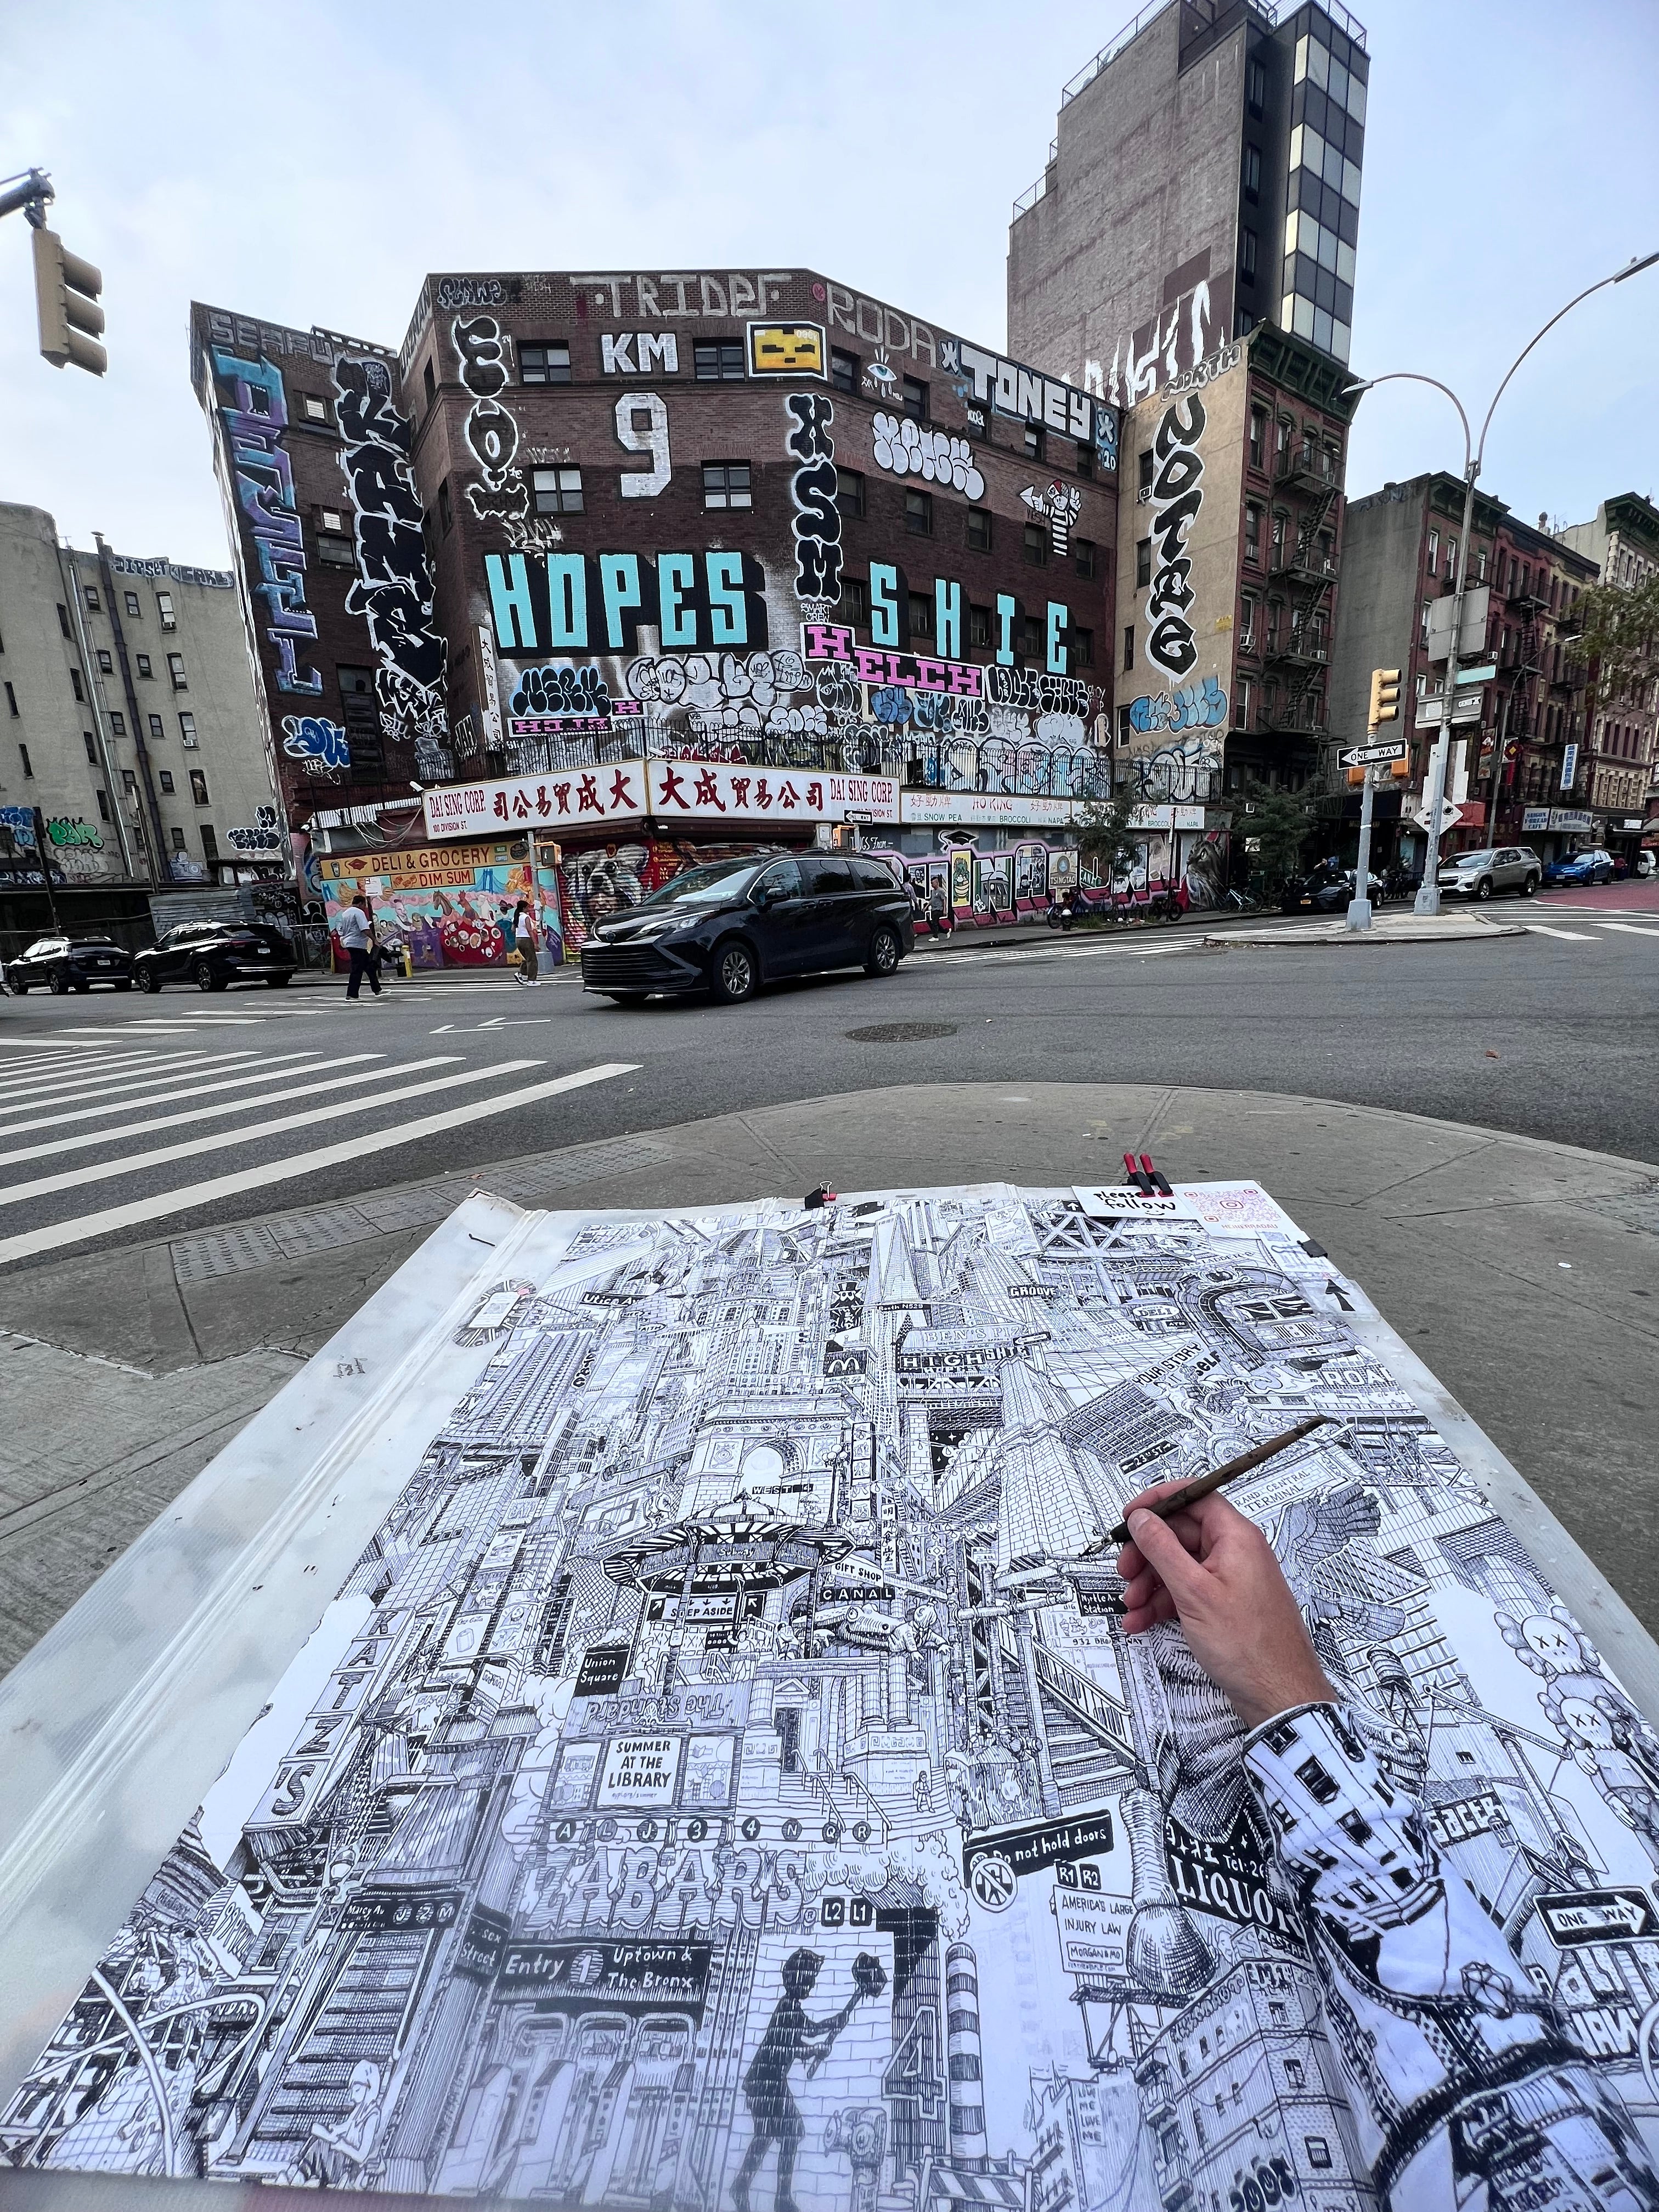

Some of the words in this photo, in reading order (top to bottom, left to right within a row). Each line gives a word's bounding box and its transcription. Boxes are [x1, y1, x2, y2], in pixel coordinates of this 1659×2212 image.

[601, 332, 679, 375] KM
[960, 344, 1091, 441] TONEY
[615, 392, 672, 498] 9
[484, 550, 748, 648] HOPES
[800, 602, 832, 614] SMART
[805, 612, 830, 623] CREW
[869, 560, 1068, 676] SHIE
[806, 624, 981, 696] HELCH
[1350, 752, 1369, 761] ONE
[1378, 746, 1398, 757] WAY
[658, 766, 824, 812] 大成貿易公司
[830, 777, 846, 801] DAI
[848, 779, 868, 803] SING
[871, 780, 893, 804] CORP.
[429, 794, 444, 819] DAI
[445, 792, 463, 817] SING
[464, 789, 487, 814] CORP.
[973, 797, 987, 811] HO
[989, 798, 1013, 812] KING
[924, 813, 945, 822] SNOW
[948, 814, 963, 822] PEA
[999, 815, 1031, 823] BROCCOLI
[1048, 816, 1064, 825] NAPA
[432, 824, 441, 833] 100
[441, 821, 460, 833] DIVISION
[372, 856, 402, 873] DELI
[406, 855, 416, 870] &
[419, 846, 490, 868] GROCERY
[420, 872, 445, 887] DIM
[447, 870, 471, 885] SUM
[1104, 1198, 1176, 1211] follow
[1009, 1286, 1057, 1296] GROOVE
[1138, 1308, 1173, 1317] DELI
[925, 1328, 987, 1342] BEN'S
[903, 1352, 984, 1368] HIGH
[1132, 1366, 1166, 1386] YOUR
[1161, 1341, 1201, 1370] STORY
[752, 1485, 791, 1495] WEST
[803, 1483, 813, 1492] 4
[1265, 1469, 1311, 1492] CENTRAL
[1244, 1485, 1304, 1512] TERMINAL
[718, 1547, 755, 1557] Subway
[834, 1563, 855, 1574] GIFT
[858, 1567, 882, 1582] SHOP
[822, 1588, 893, 1600] CANAL
[1081, 1593, 1107, 1604] Myrtle
[1107, 1594, 1116, 1602] Av
[702, 1606, 733, 1616] ASIDE
[1084, 1604, 1115, 1613] Station
[584, 1657, 616, 1669] Union
[580, 1671, 619, 1686] Square
[271, 1610, 401, 1815] KATZ'S
[616, 1740, 671, 1754] SUMMER
[620, 1756, 637, 1769] AT
[640, 1756, 663, 1769] THE
[608, 1771, 672, 1788] LIBRARY
[1014, 1842, 1039, 1863] not
[1041, 1832, 1071, 1855] hold
[1073, 1826, 1107, 1848] doors
[1059, 1867, 1075, 1883] R1
[1082, 1869, 1099, 1886] R2
[347, 1905, 370, 1919] Marcy
[824, 1903, 842, 1920] L2
[853, 1904, 867, 1920] L1
[1062, 1894, 1107, 1913] AMERICA'S
[1555, 1911, 1588, 1928] ONE
[1601, 1905, 1637, 1921] WAY
[1063, 1918, 1096, 1935] INJURY
[1099, 1920, 1122, 1937] LAW
[460, 1942, 496, 1968] Street
[612, 1946, 676, 1966] Uptown
[681, 1946, 693, 1961] &
[505, 1955, 564, 1980] Entry
[607, 1973, 638, 1990] The
[641, 1971, 694, 1990] Bronx
[882, 2005, 947, 2119] 4
